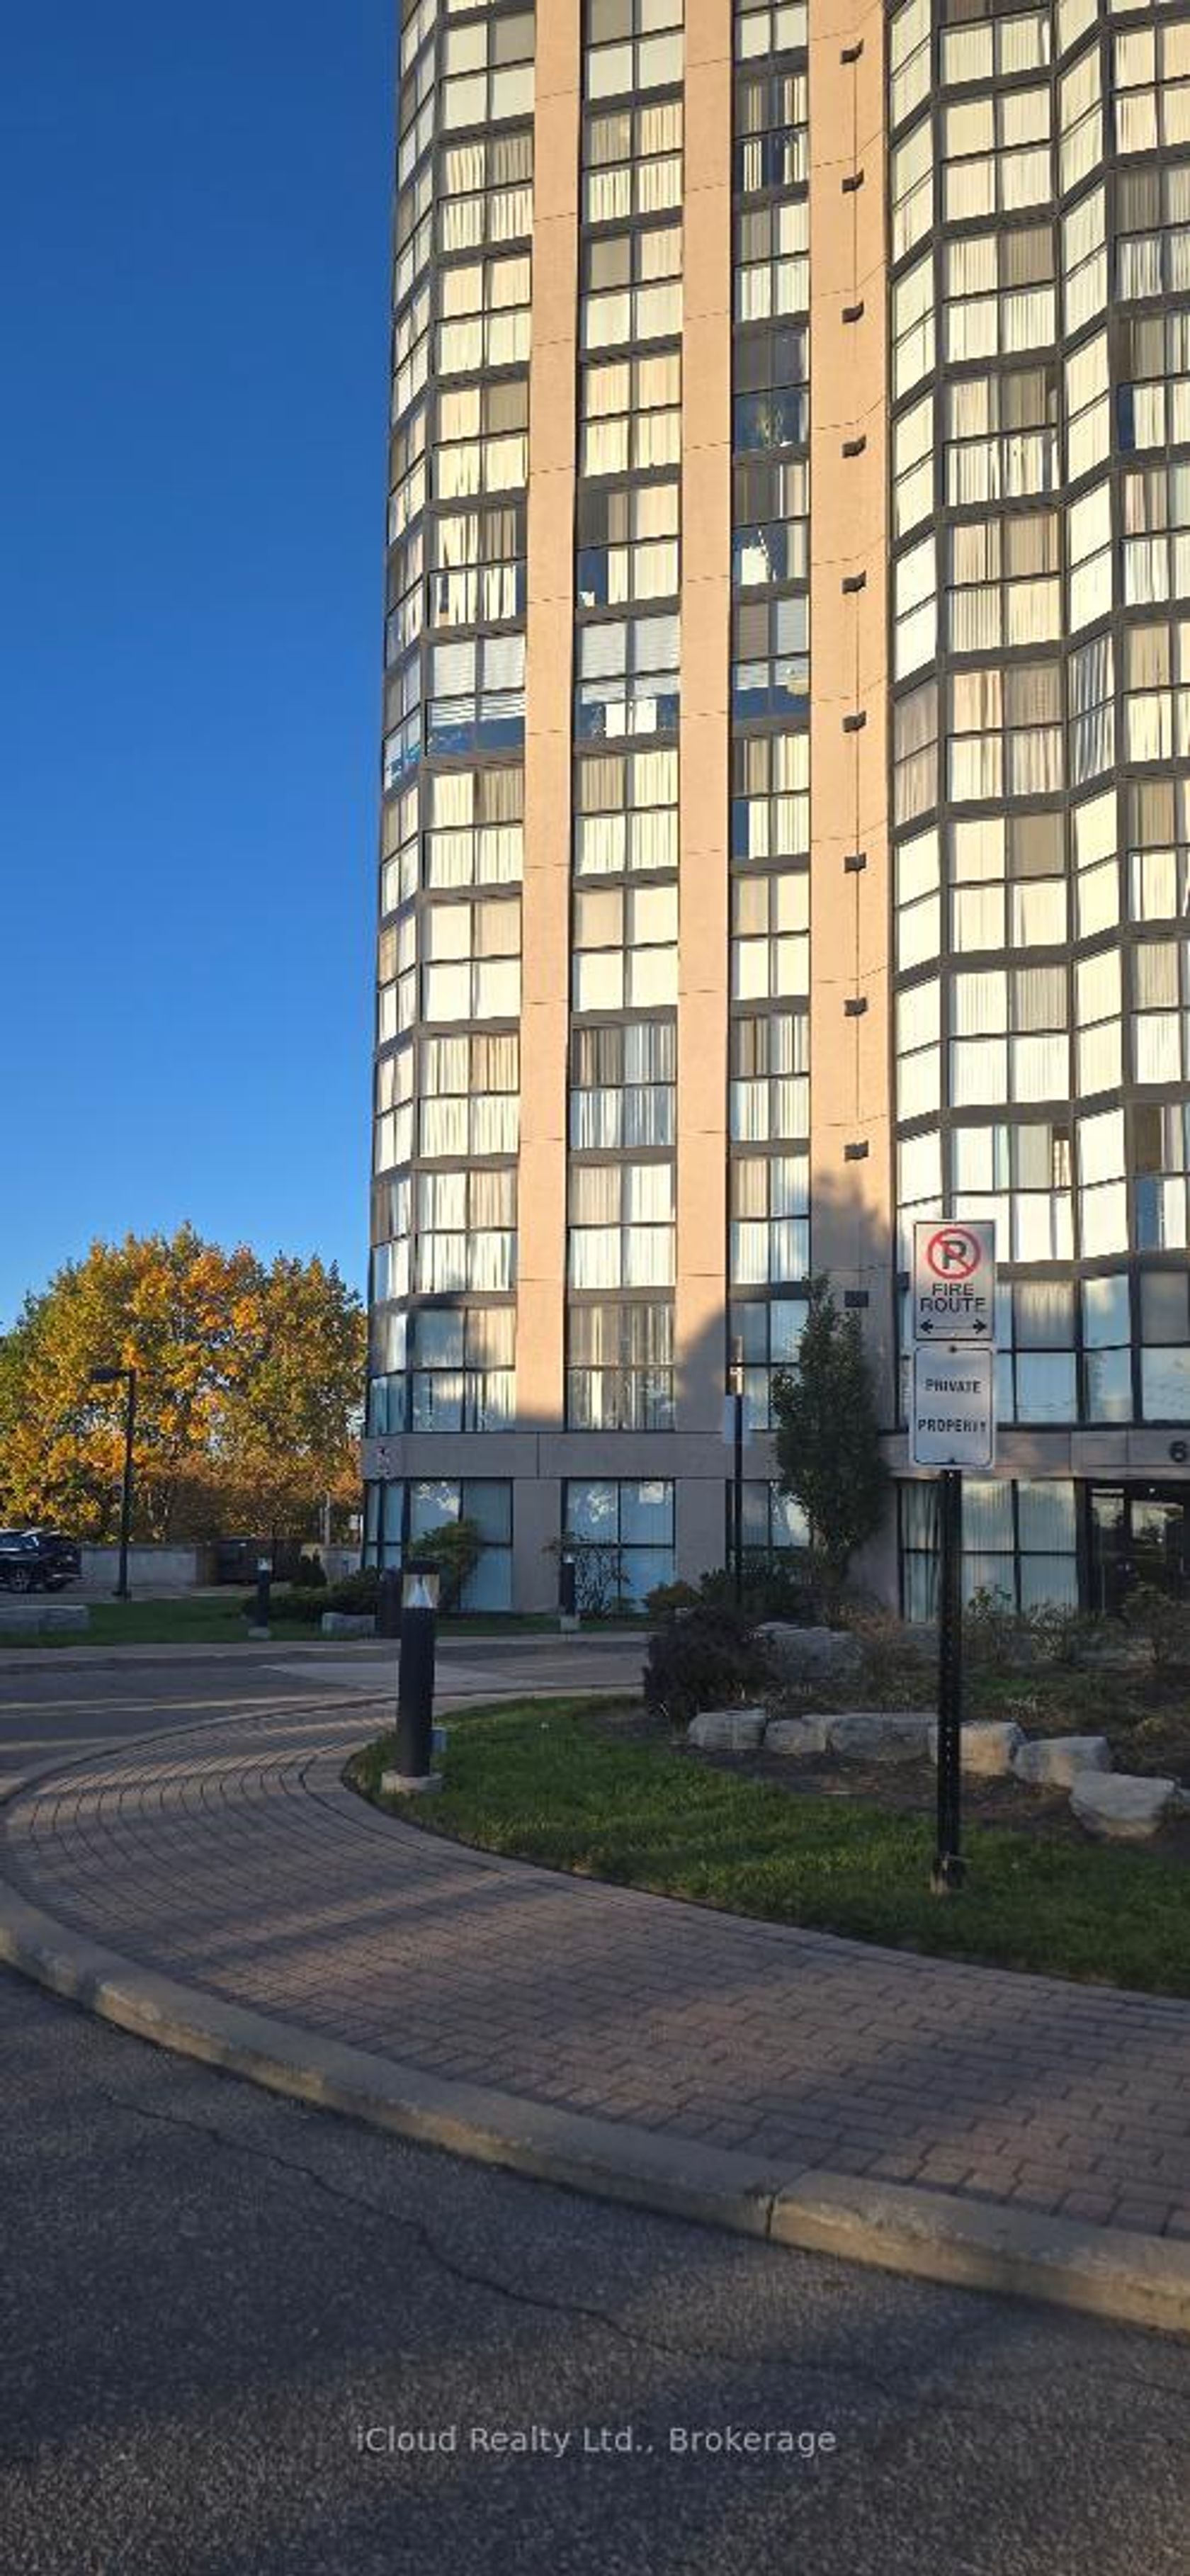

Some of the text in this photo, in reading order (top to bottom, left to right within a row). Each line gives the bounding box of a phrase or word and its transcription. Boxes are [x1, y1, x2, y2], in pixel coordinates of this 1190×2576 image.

[931, 1283, 974, 1297] FIRE
[920, 1297, 987, 1313] ROUTE
[925, 1379, 982, 1394] PRIVATE
[918, 1418, 986, 1433] PROPERTY
